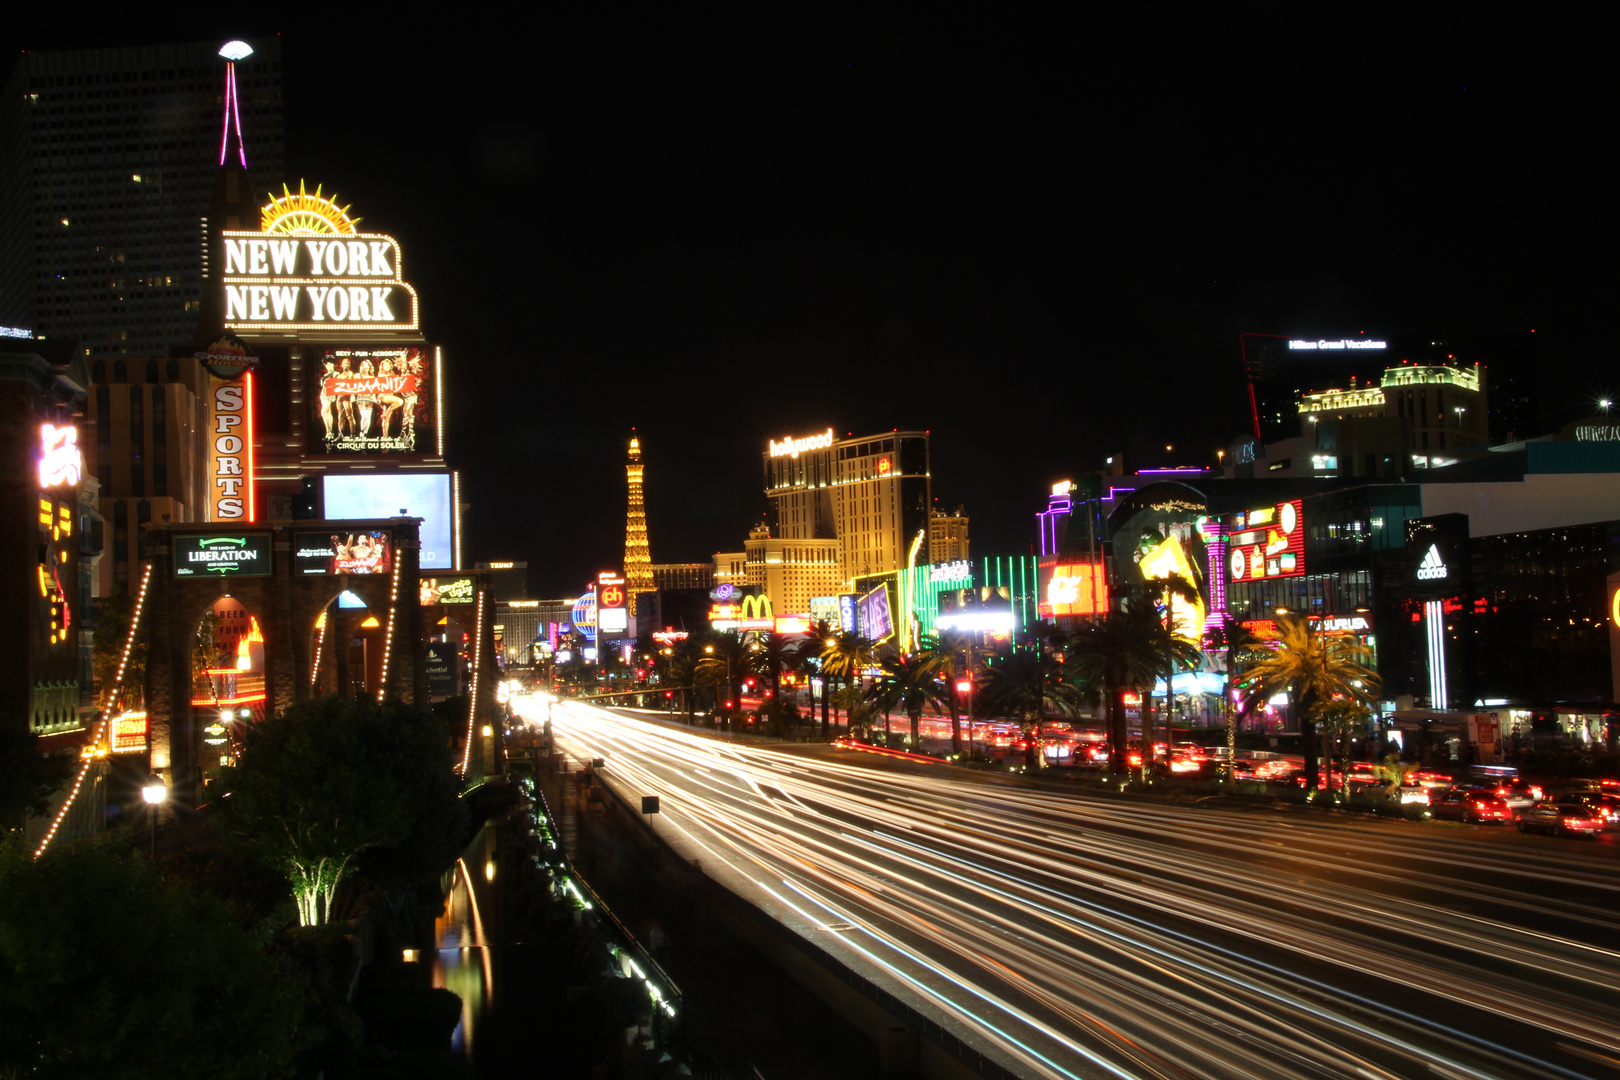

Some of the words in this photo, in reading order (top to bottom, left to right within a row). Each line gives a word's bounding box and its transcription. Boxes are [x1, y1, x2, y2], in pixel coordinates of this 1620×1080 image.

[224, 239, 299, 275] NEW
[305, 240, 394, 276] YORK
[225, 285, 300, 320] NEW
[306, 286, 395, 321] YORK
[1288, 339, 1318, 350] Hilton
[1318, 339, 1345, 349] Grand
[1345, 339, 1387, 349] Vacations
[333, 376, 408, 393] ZUMANITY
[336, 442, 366, 451] CIRQUE
[769, 427, 833, 458] hollywood
[215, 386, 244, 518] SPORTS
[188, 550, 257, 562] LIBERATION
[1417, 566, 1447, 580] adidas
[220, 610, 245, 618] BEER
